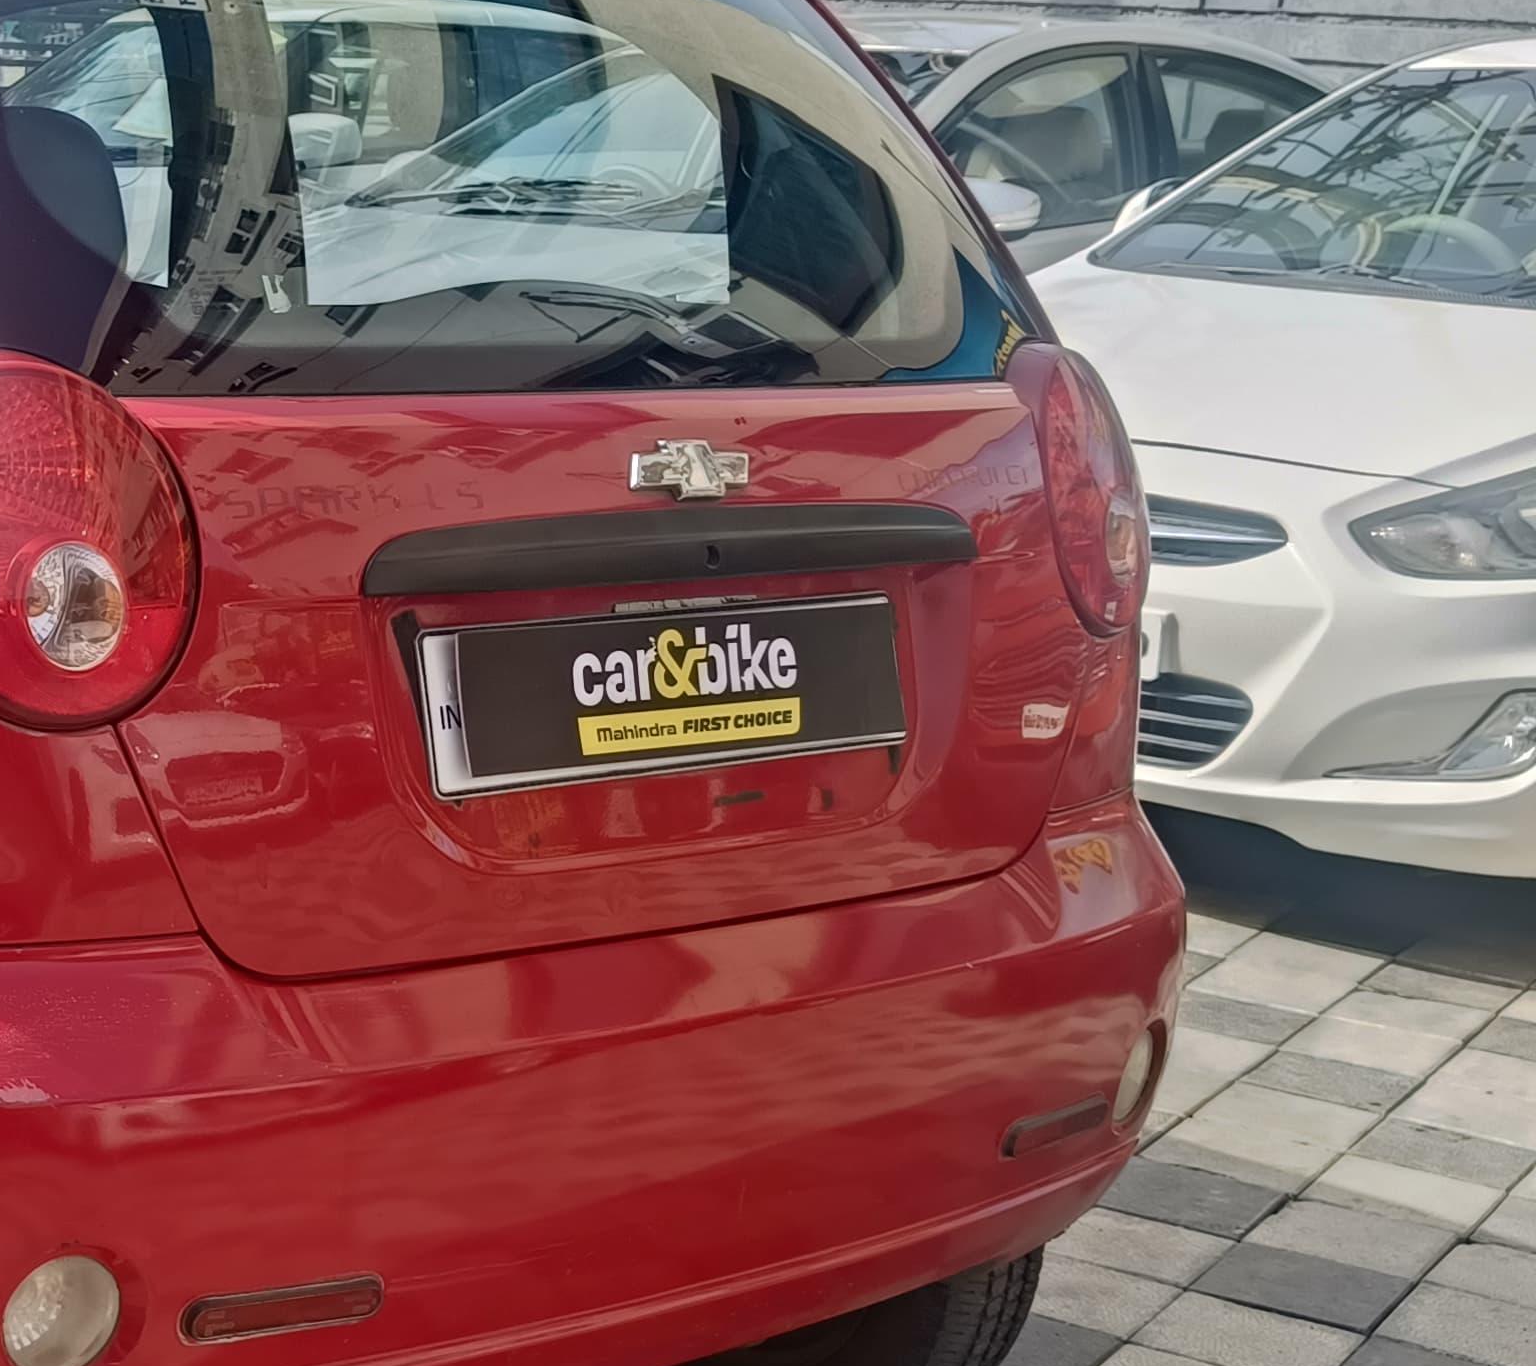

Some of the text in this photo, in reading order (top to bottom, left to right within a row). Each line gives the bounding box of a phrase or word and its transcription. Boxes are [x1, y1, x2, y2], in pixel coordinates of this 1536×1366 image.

[572, 623, 798, 707] car&bike
[596, 710, 793, 743] Mahindra FIRST CHOICE
